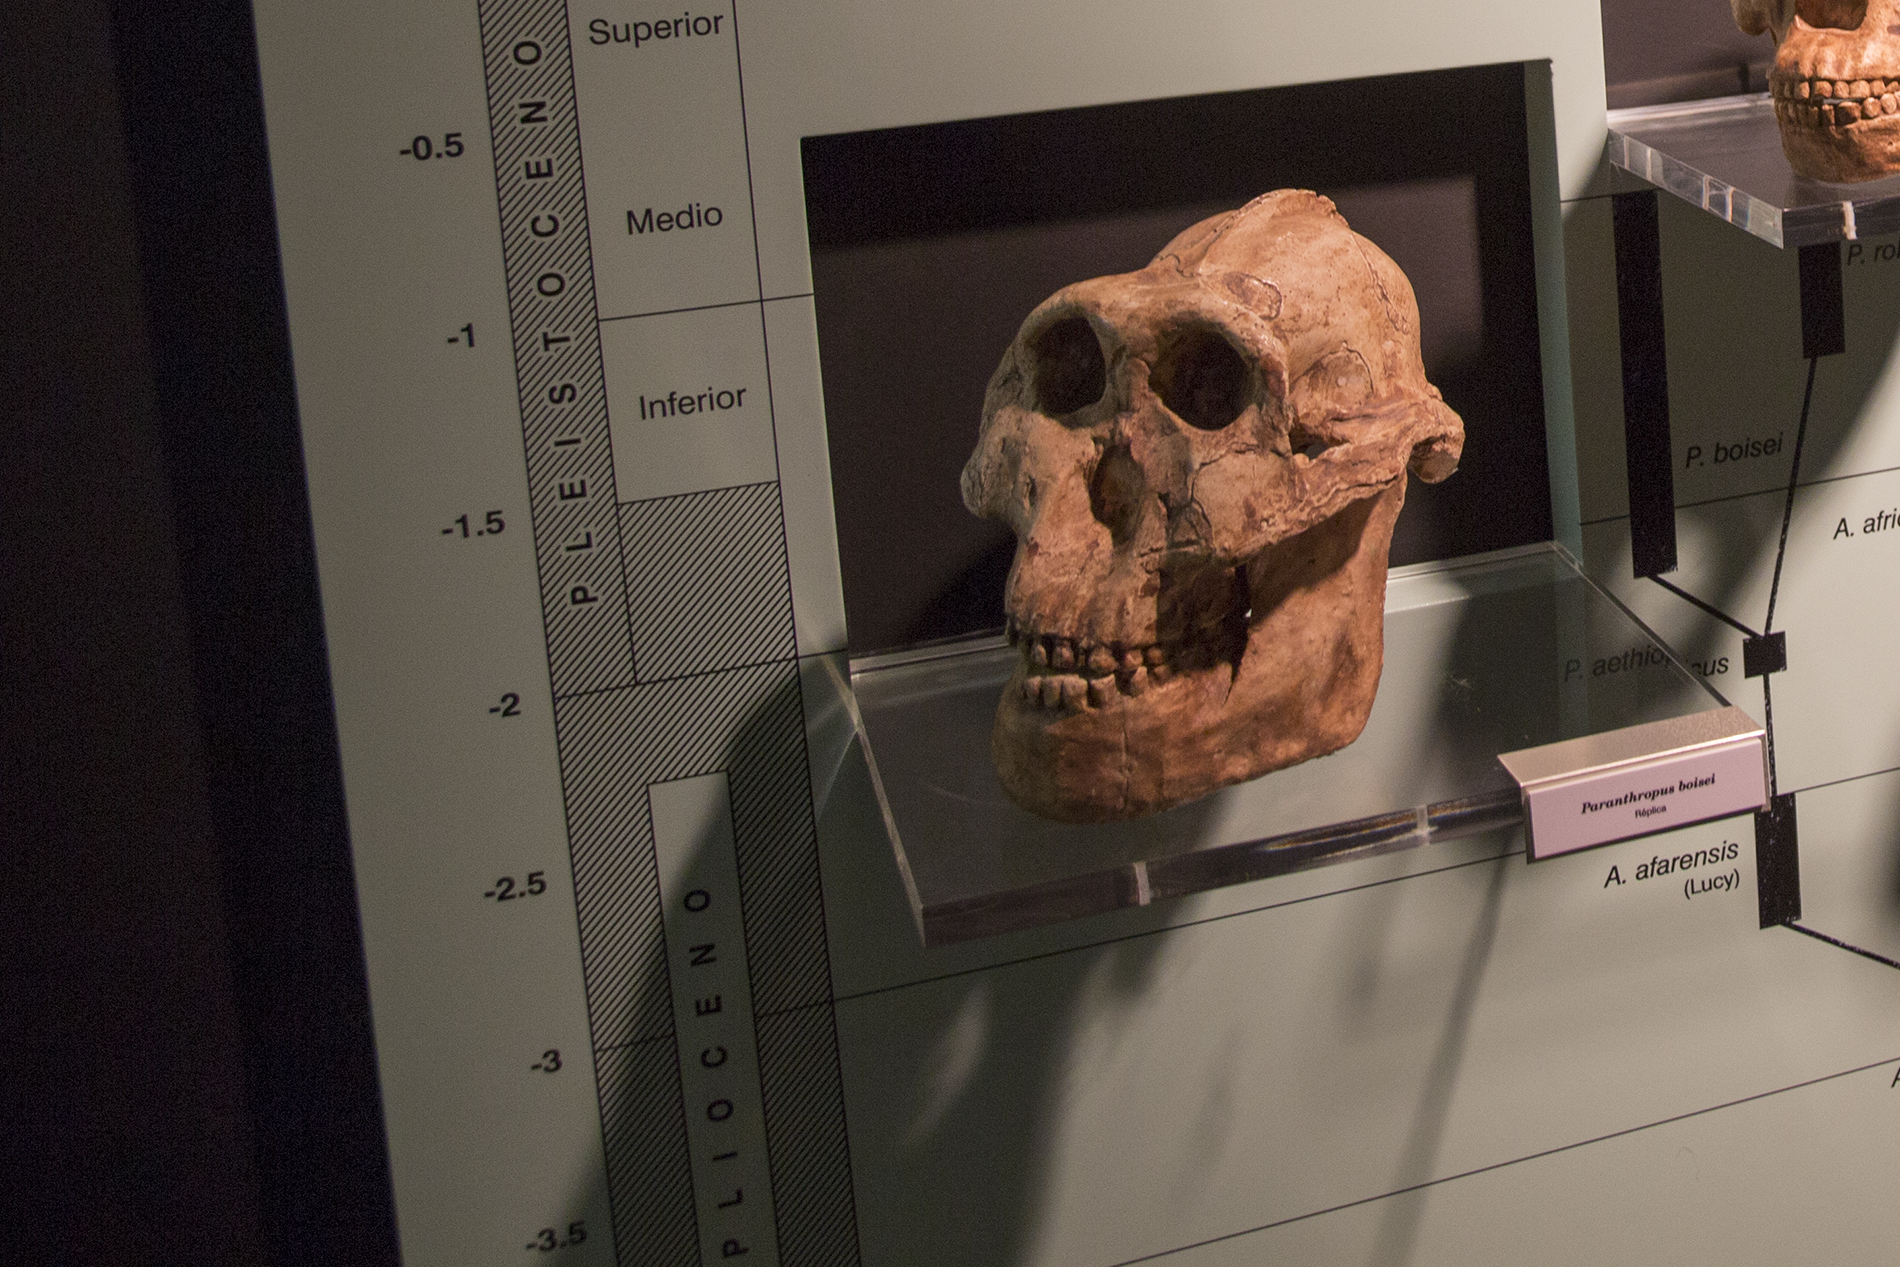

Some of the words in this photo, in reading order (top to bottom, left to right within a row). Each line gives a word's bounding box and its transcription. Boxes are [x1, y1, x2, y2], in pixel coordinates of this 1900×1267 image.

[588, 12, 724, 48] Superior
[399, 134, 464, 160] -0.5
[626, 204, 723, 235] Medio
[1847, 244, 1865, 265] P.
[446, 324, 476, 348] -1
[639, 387, 746, 420] Inferior
[1685, 446, 1704, 469] P.
[1715, 432, 1783, 464] boisei
[441, 511, 505, 542] -1.5
[1833, 517, 1855, 540] A.
[488, 694, 520, 719] -2
[1581, 782, 1675, 815] Paranthropus
[1678, 773, 1715, 793] boisei
[1635, 804, 1667, 819] Réplica
[1604, 865, 1627, 888] A.
[1636, 840, 1739, 880] afarensis
[483, 872, 547, 902] -2.5
[1684, 869, 1740, 899] (Lucy)
[531, 1050, 562, 1074] -3
[526, 1221, 587, 1252] -3.5
